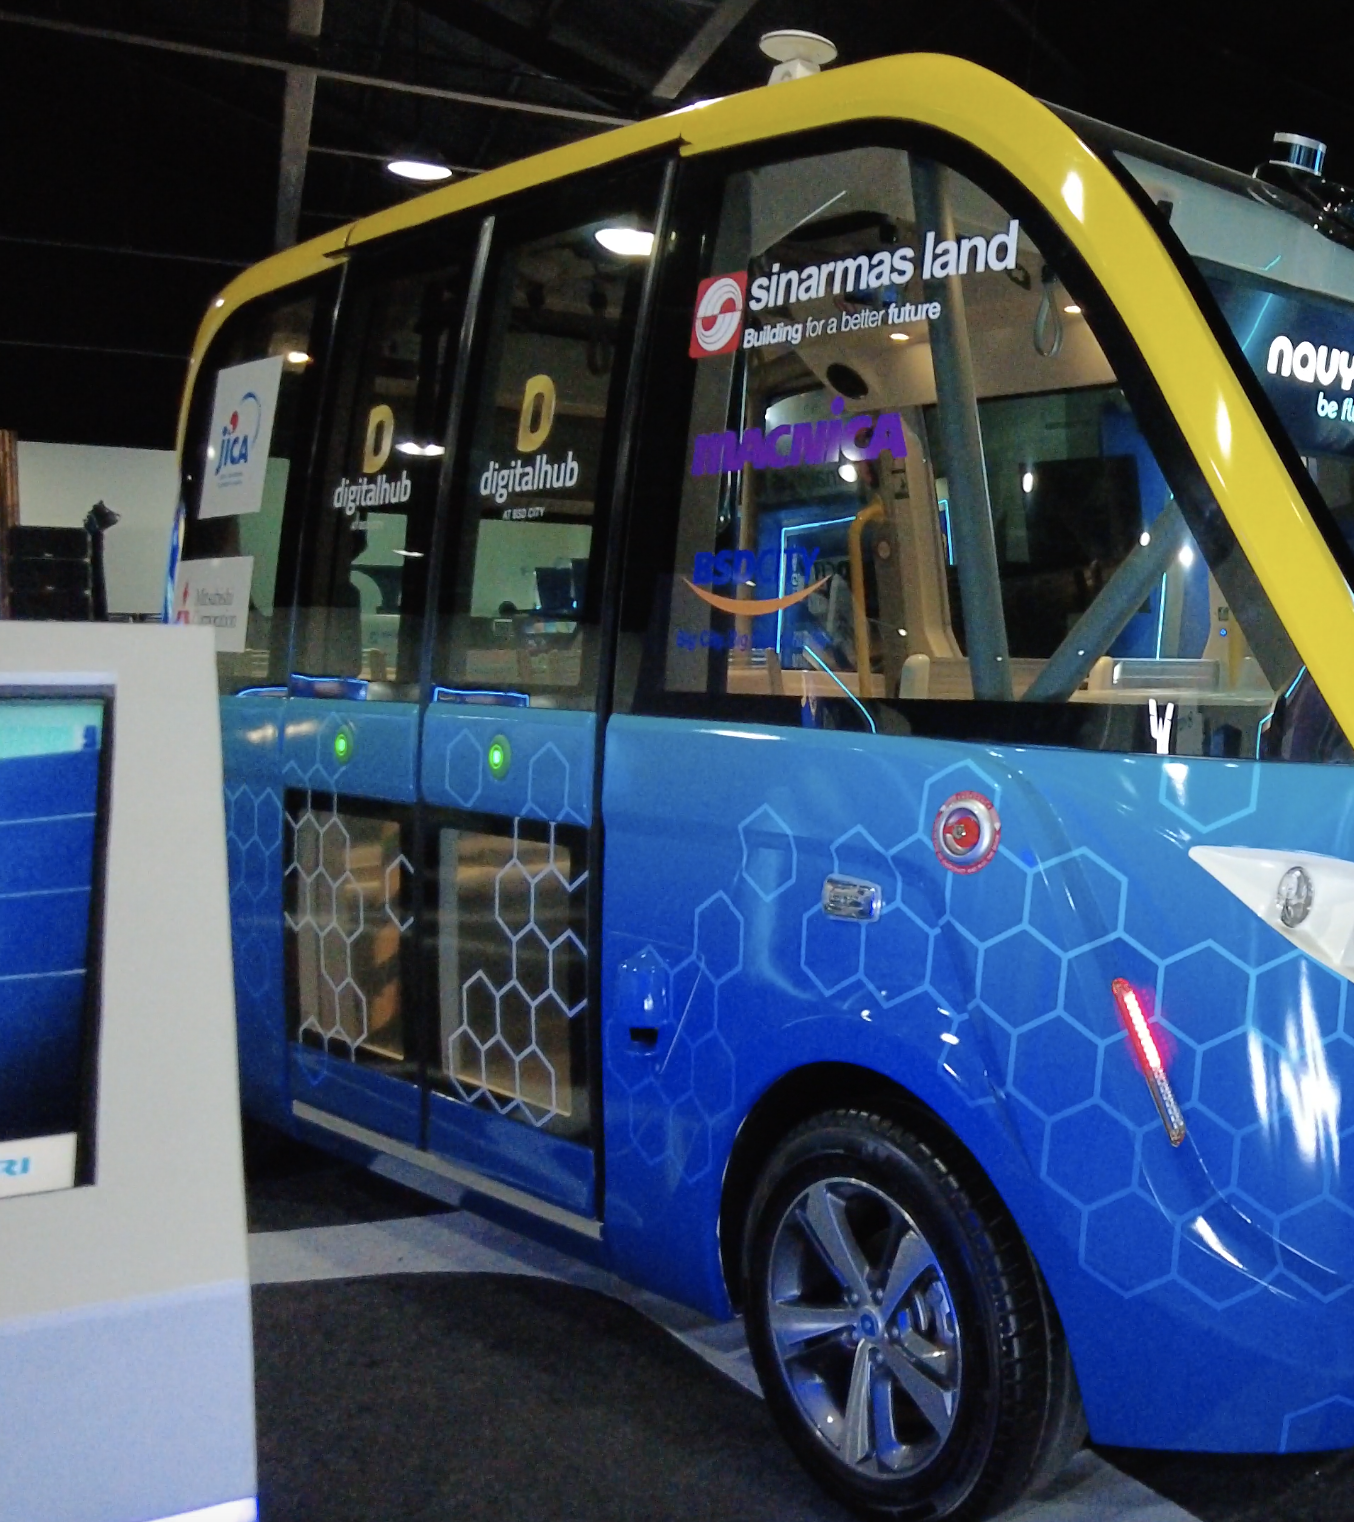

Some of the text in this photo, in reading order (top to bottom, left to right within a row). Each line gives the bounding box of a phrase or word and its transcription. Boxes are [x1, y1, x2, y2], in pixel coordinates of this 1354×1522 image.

[749, 219, 1020, 312] sinarmas land
[743, 301, 941, 350] Building for a better future
[1317, 391, 1339, 419] be
[333, 469, 412, 516] digitalhub
[479, 451, 579, 504] digitalhub
